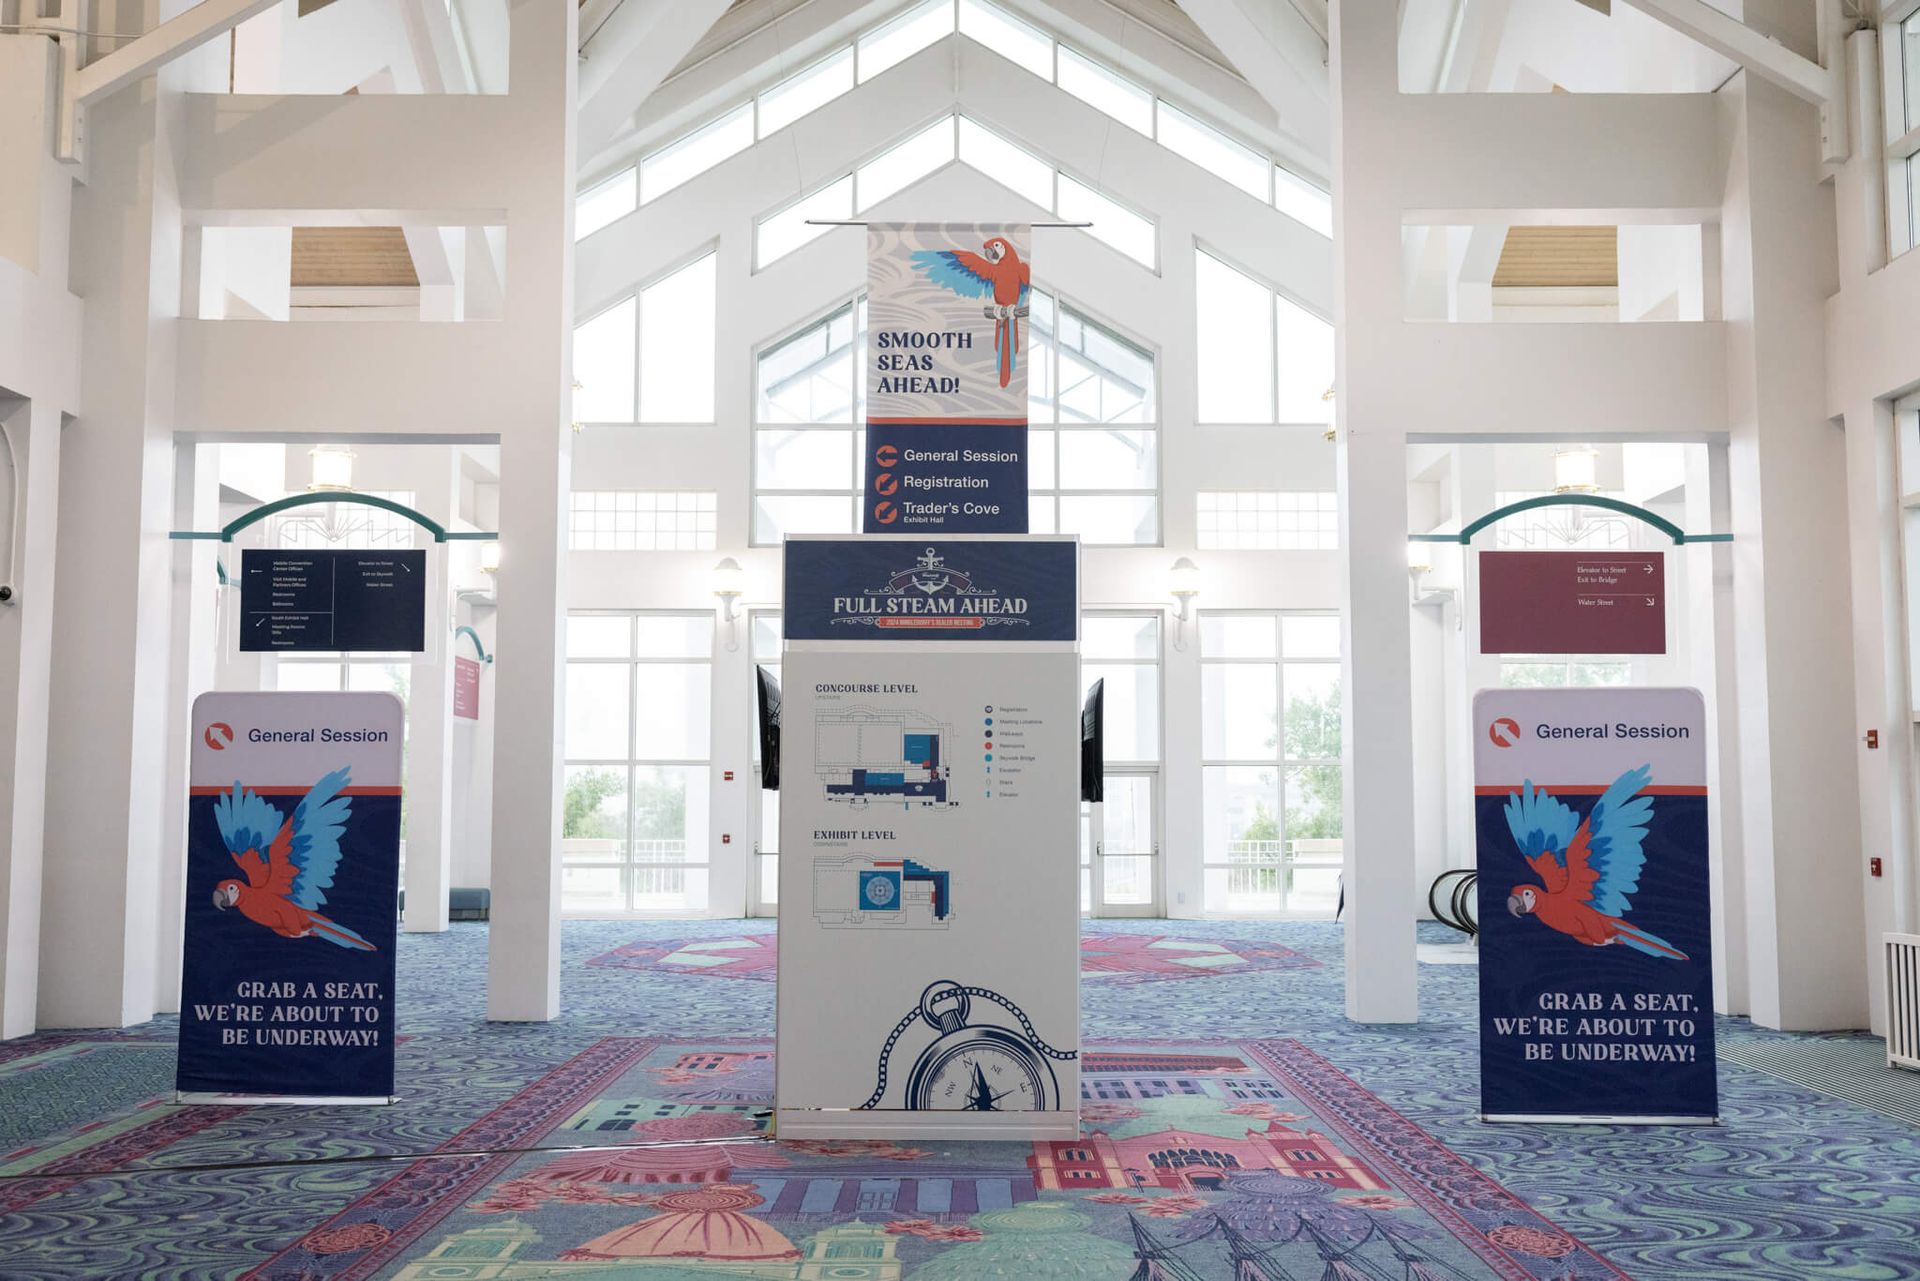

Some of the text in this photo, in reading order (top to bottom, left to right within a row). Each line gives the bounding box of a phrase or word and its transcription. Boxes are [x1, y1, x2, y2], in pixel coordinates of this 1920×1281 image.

[878, 332, 972, 349] SMOOTH
[878, 354, 932, 371] SEAS
[877, 378, 960, 394] AHEAD!
[904, 450, 1018, 462] General Session
[904, 476, 989, 490] Registration
[904, 502, 1000, 514] Trader's Cove
[1599, 576, 1618, 584] Bridge
[834, 598, 1027, 614] FULL STEAM AHEAD
[816, 684, 918, 693] CONCOURSE LEVEL
[249, 729, 388, 742] General Session
[1536, 724, 1689, 738] General Session
[814, 830, 896, 840] EXHIBIT LEVEL
[237, 982, 383, 1000] GRAB A SEAT,
[1539, 993, 1699, 1013] GRAB A SEAT,
[194, 1003, 379, 1023] WE'RE ABOUT TO
[1493, 1016, 1695, 1036] WE'RE ABOUT TO
[222, 1029, 378, 1046] BE UNDERWAY!
[1525, 1044, 1695, 1062] BE UNDERWAY!
[963, 1056, 973, 1069] N
[945, 1081, 957, 1097] NW
[1019, 1082, 1028, 1093] E
